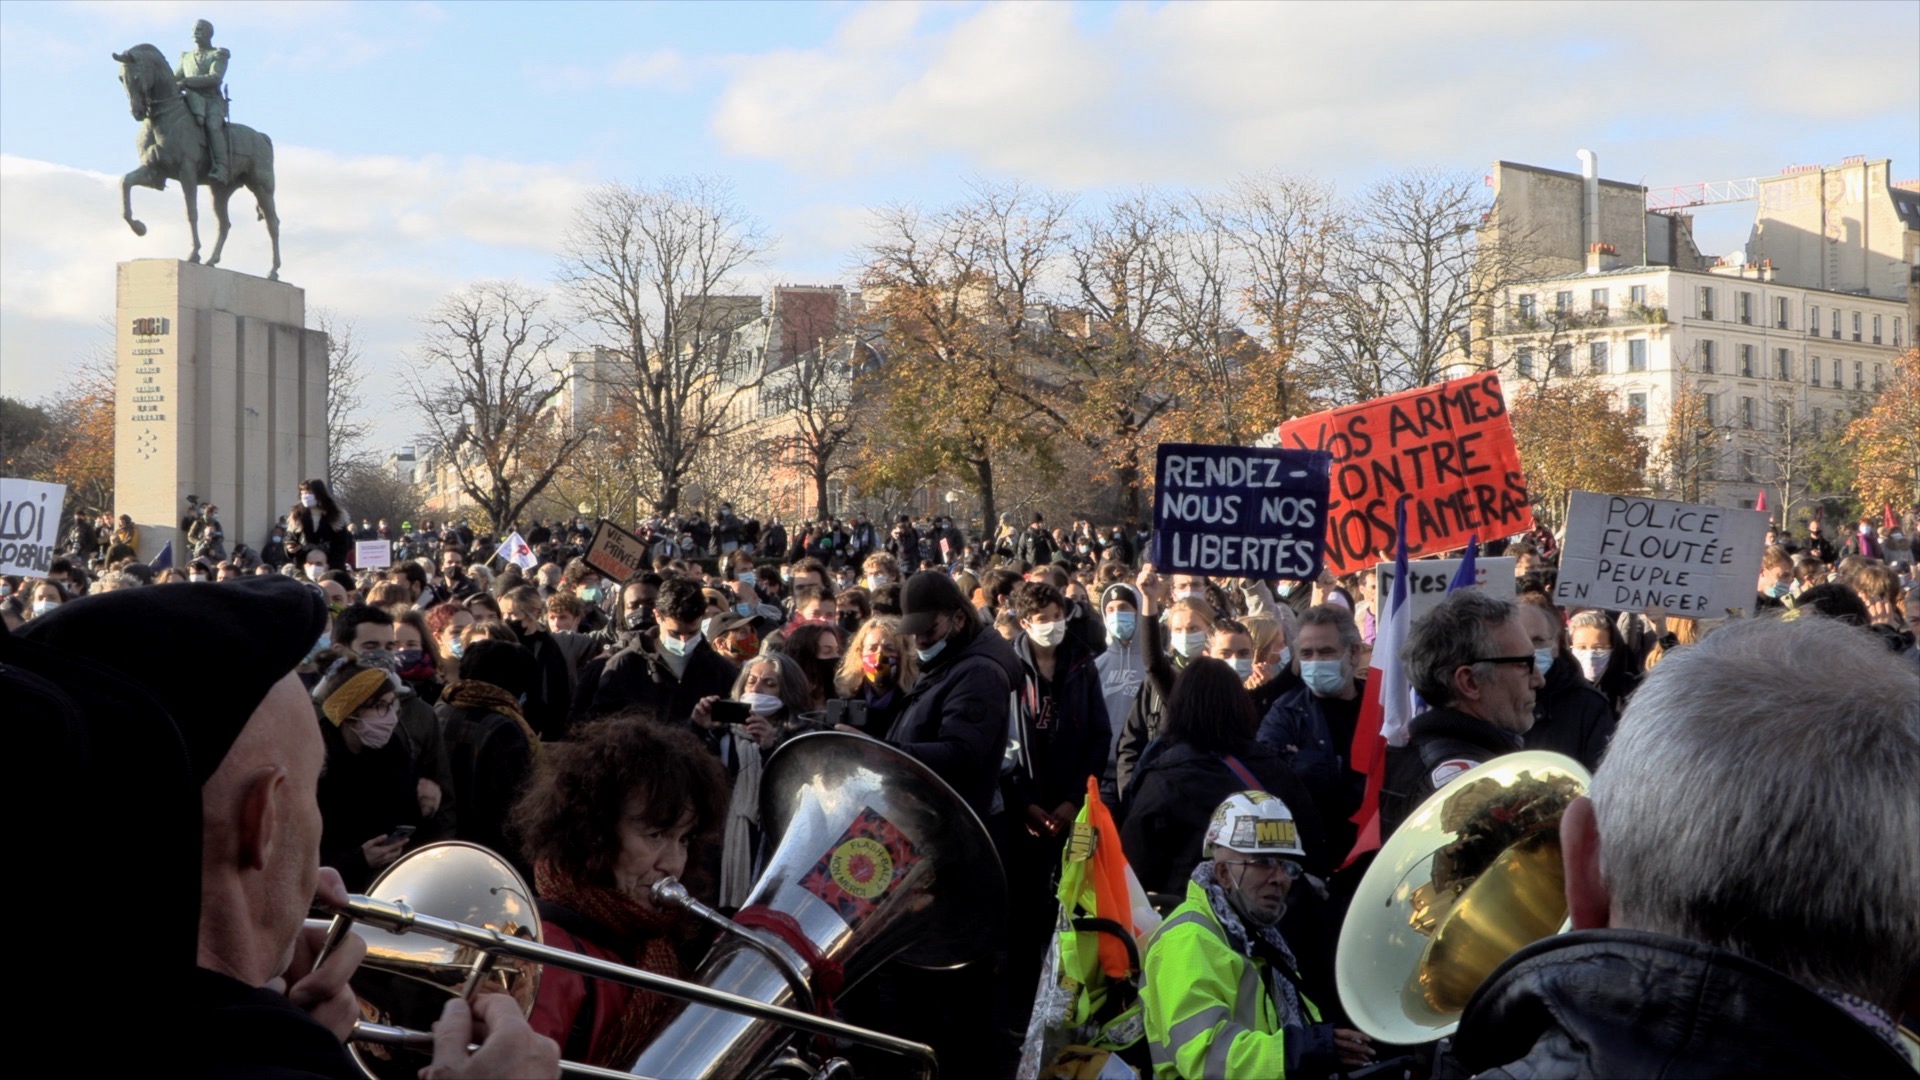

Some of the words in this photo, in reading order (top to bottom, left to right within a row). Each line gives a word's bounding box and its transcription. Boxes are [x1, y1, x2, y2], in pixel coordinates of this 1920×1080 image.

[1292, 415, 1372, 464] VOS
[1390, 375, 1506, 448] ARMES
[1329, 431, 1491, 510] ONTRE
[1162, 492, 1242, 525] NOUS
[1260, 497, 1317, 528] NOS
[1172, 532, 1315, 577] LIBERTÉS
[1600, 529, 1734, 564] FLOUTÉE
[1597, 559, 1690, 586] PEUPLE
[1558, 582, 1589, 599] EN
[1615, 586, 1708, 611] DANGER
[1106, 669, 1137, 684] NIKE
